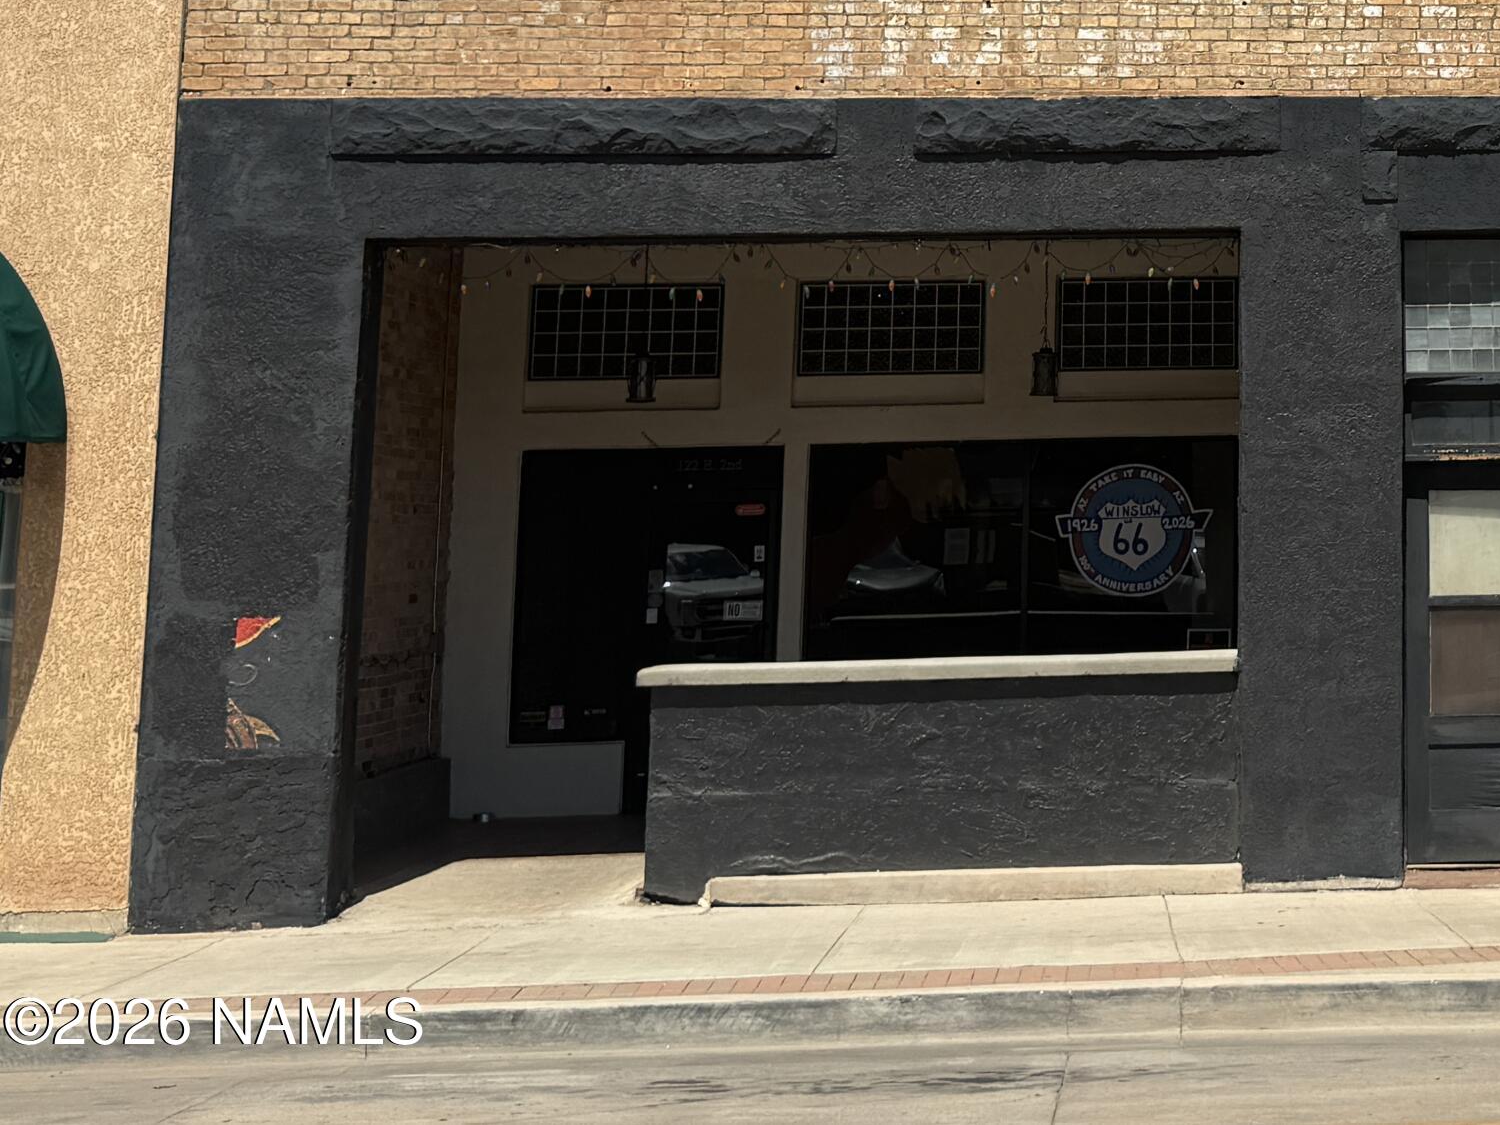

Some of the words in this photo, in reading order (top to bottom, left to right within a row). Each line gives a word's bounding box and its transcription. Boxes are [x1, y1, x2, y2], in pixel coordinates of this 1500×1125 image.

[1089, 472, 1118, 491] TAKE
[1123, 469, 1134, 478] IT
[1140, 470, 1165, 483] EASY
[1104, 504, 1161, 517] WINSLOW
[1067, 518, 1098, 532] 1926
[1162, 516, 1195, 530] 2026
[1113, 523, 1149, 556] 66
[1094, 566, 1174, 592] ANNIVERSARY
[728, 603, 741, 617] NO
